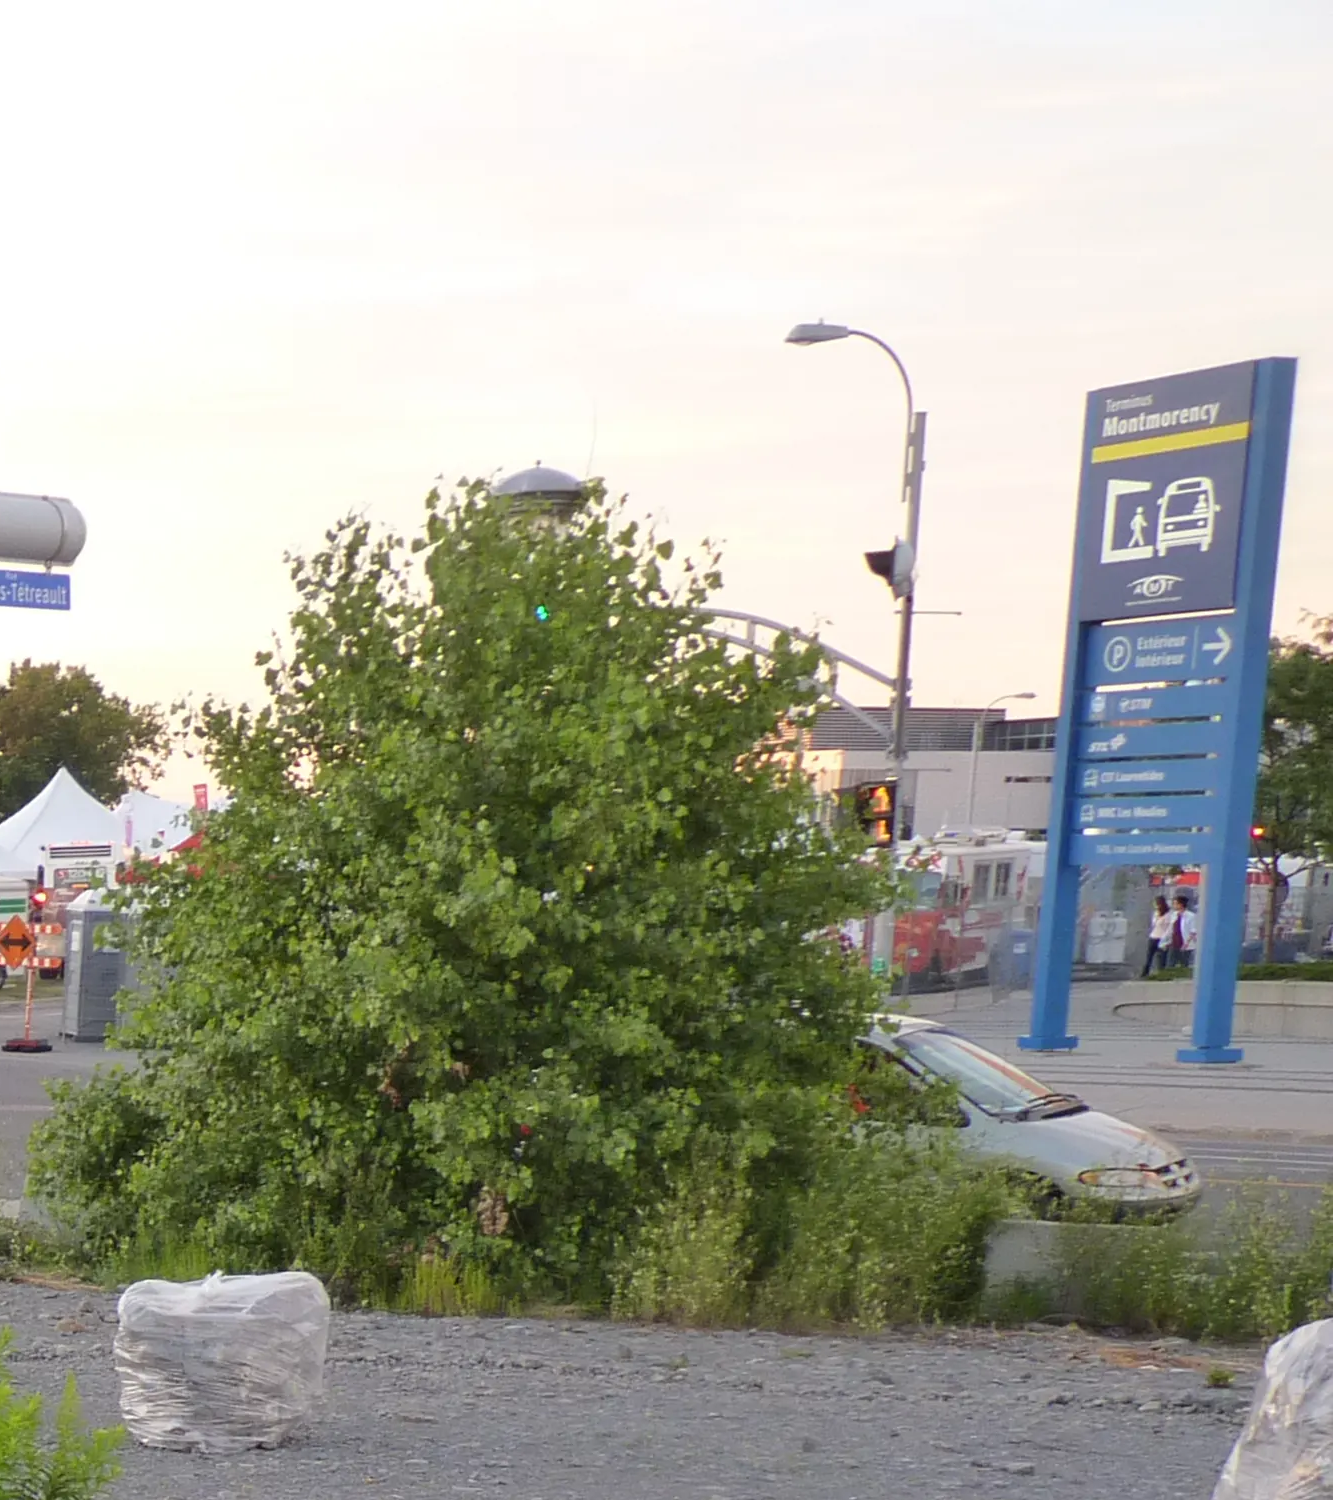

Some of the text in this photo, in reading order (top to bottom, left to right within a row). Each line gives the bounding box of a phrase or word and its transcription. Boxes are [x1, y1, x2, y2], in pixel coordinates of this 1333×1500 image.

[1105, 394, 1154, 413] Terminus
[1102, 402, 1221, 438] Montmorency
[1136, 635, 1188, 650] Extérieur
[1135, 652, 1185, 668] Intérieur
